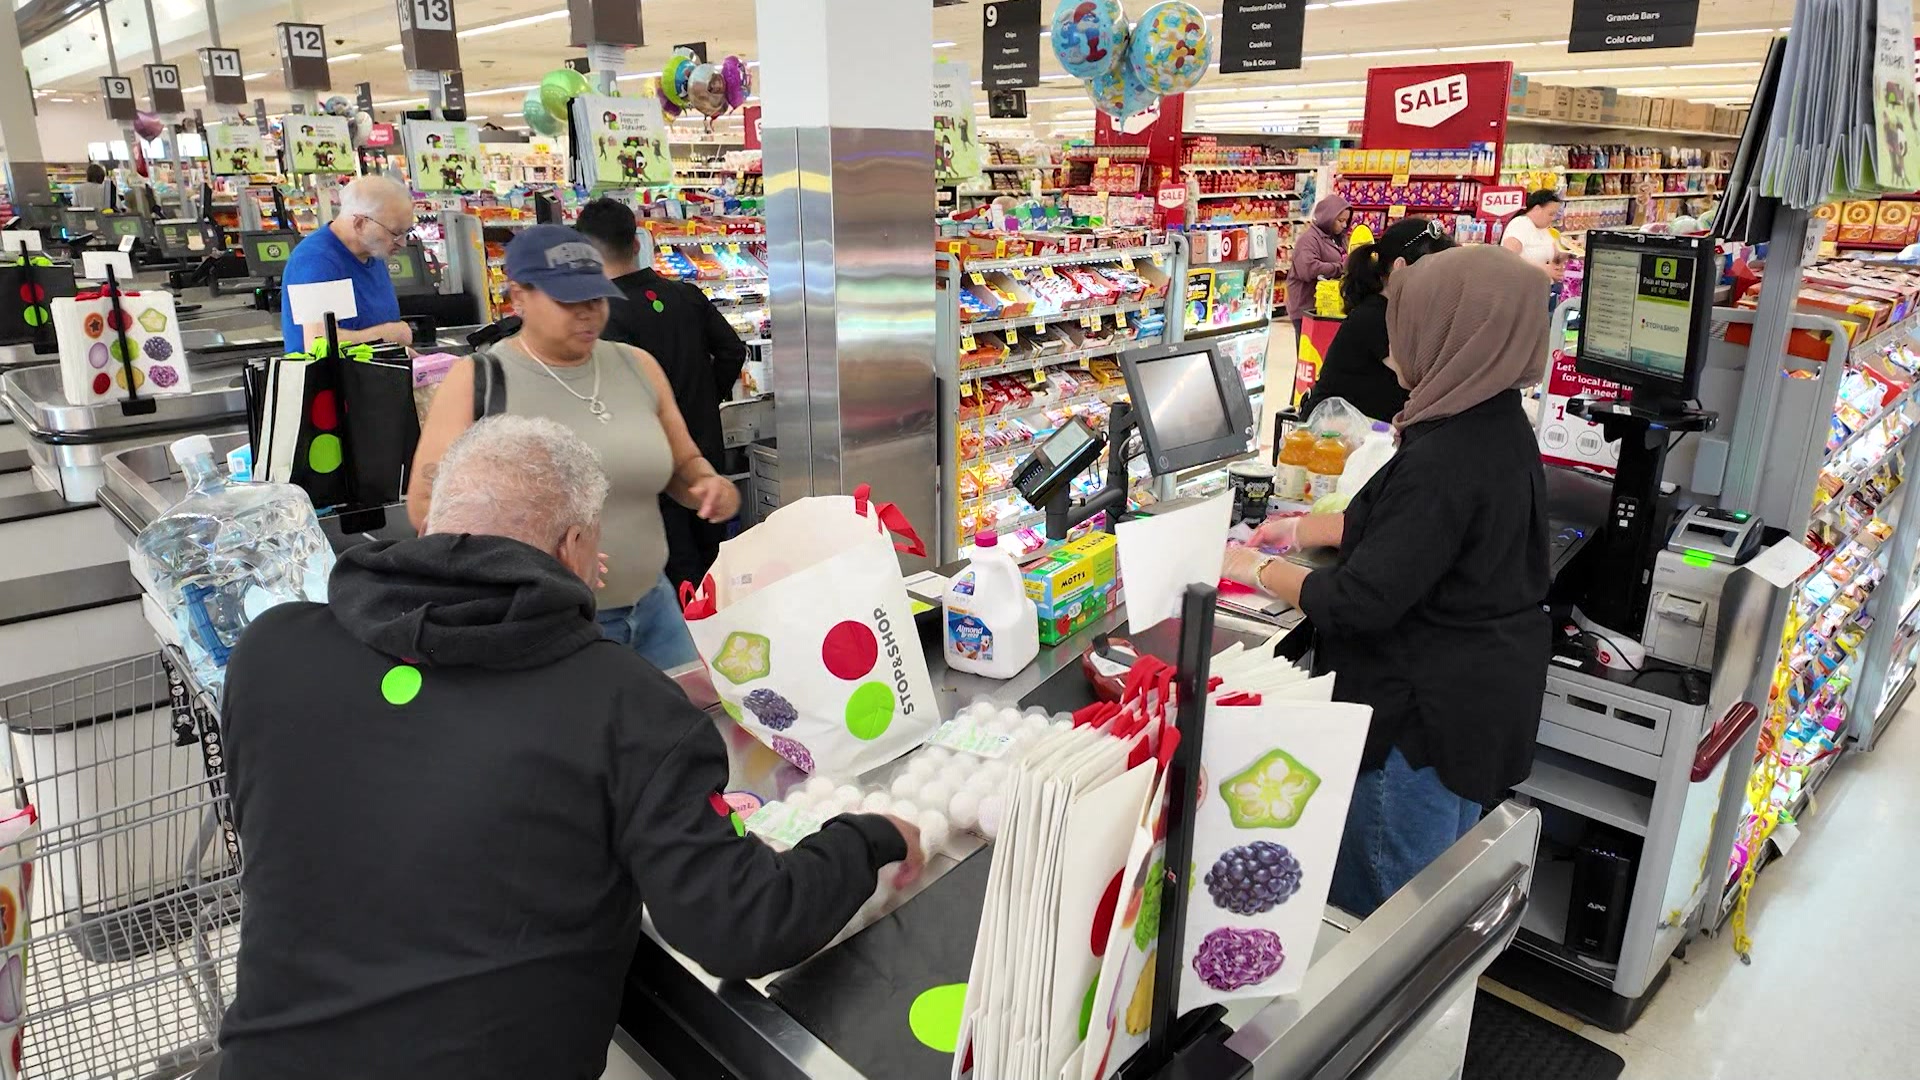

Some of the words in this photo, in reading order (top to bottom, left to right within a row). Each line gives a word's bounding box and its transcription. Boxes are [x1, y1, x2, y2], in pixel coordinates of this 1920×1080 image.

[417, 0, 449, 22] 13
[1239, 5, 1267, 13] Powdered
[1267, 2, 1286, 10] Drinks
[986, 5, 998, 27] 9
[1606, 12, 1640, 22] Granola
[1640, 11, 1660, 20] Bars
[1251, 22, 1271, 30] Coffee
[294, 31, 321, 51] 12
[1249, 41, 1273, 49] Cookies
[1605, 36, 1625, 44] Cold
[1626, 34, 1655, 43] Cereal
[214, 54, 234, 70] 11
[155, 69, 176, 84] 10
[114, 81, 125, 94] 9
[1400, 81, 1463, 113] SALE
[1161, 190, 1183, 201] SALE
[1485, 193, 1520, 207] SALE
[1646, 321, 1680, 333] STOP&SHOP
[1562, 373, 1577, 381] for
[1578, 374, 1600, 387] local
[1581, 386, 1592, 394] in
[1594, 388, 1618, 399] need
[956, 624, 983, 634] Almond
[873, 607, 914, 716] STOP&SHOP
[1587, 902, 1607, 912] APC
